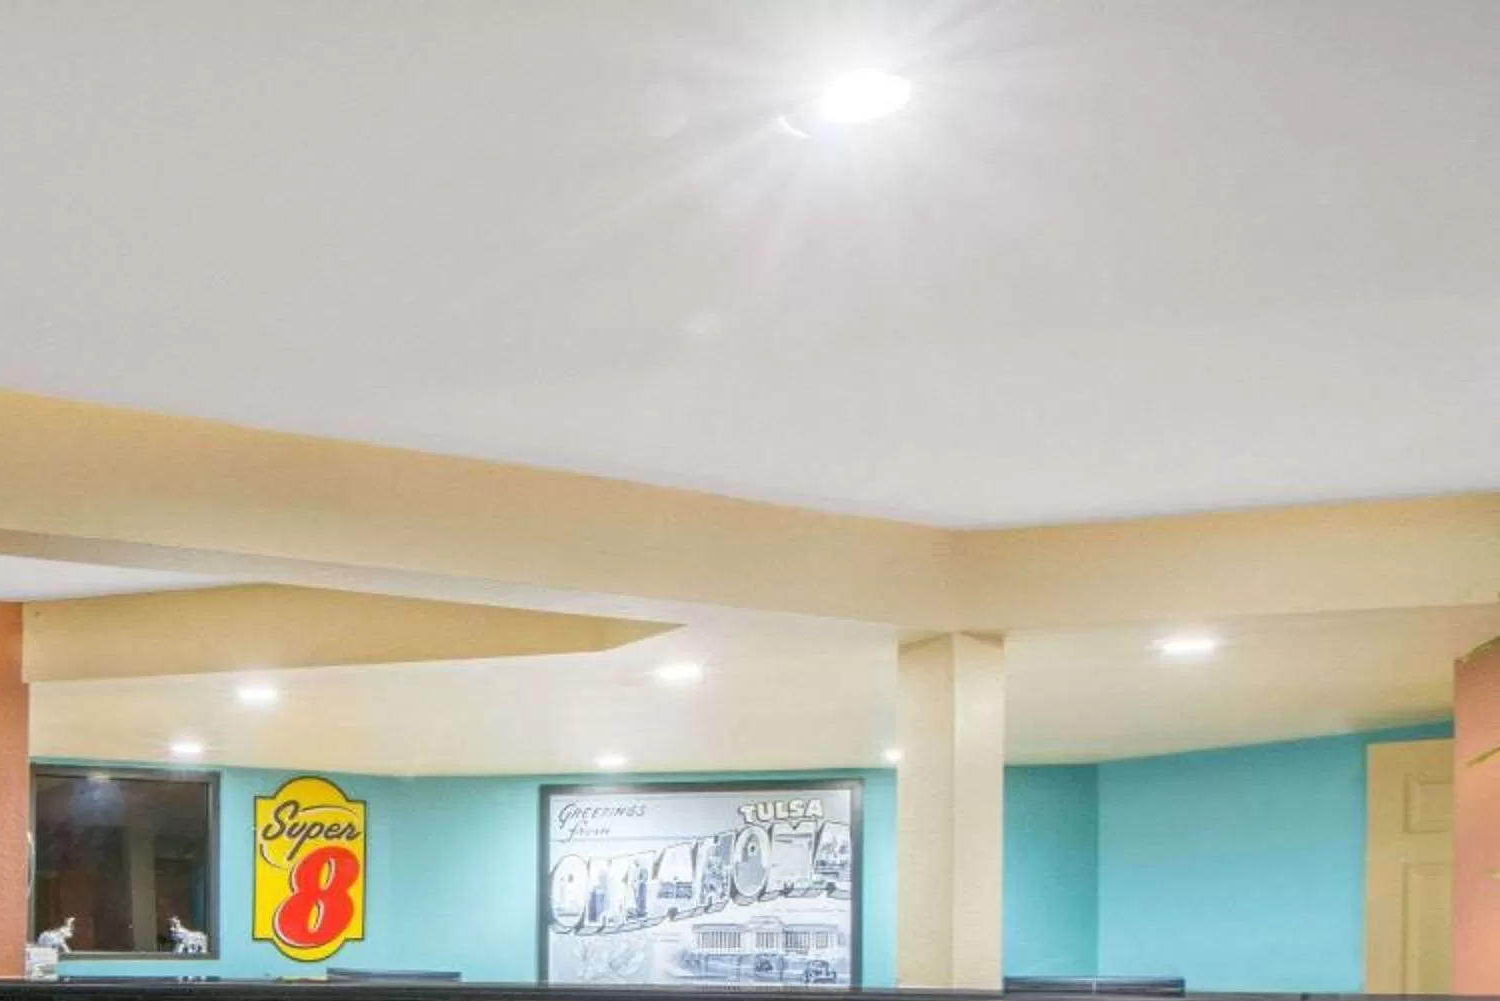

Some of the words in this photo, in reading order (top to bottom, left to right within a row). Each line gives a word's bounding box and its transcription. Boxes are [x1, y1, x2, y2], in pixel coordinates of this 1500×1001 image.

[262, 800, 362, 861] Super
[737, 799, 825, 825] TULSA
[273, 846, 361, 949] 8
